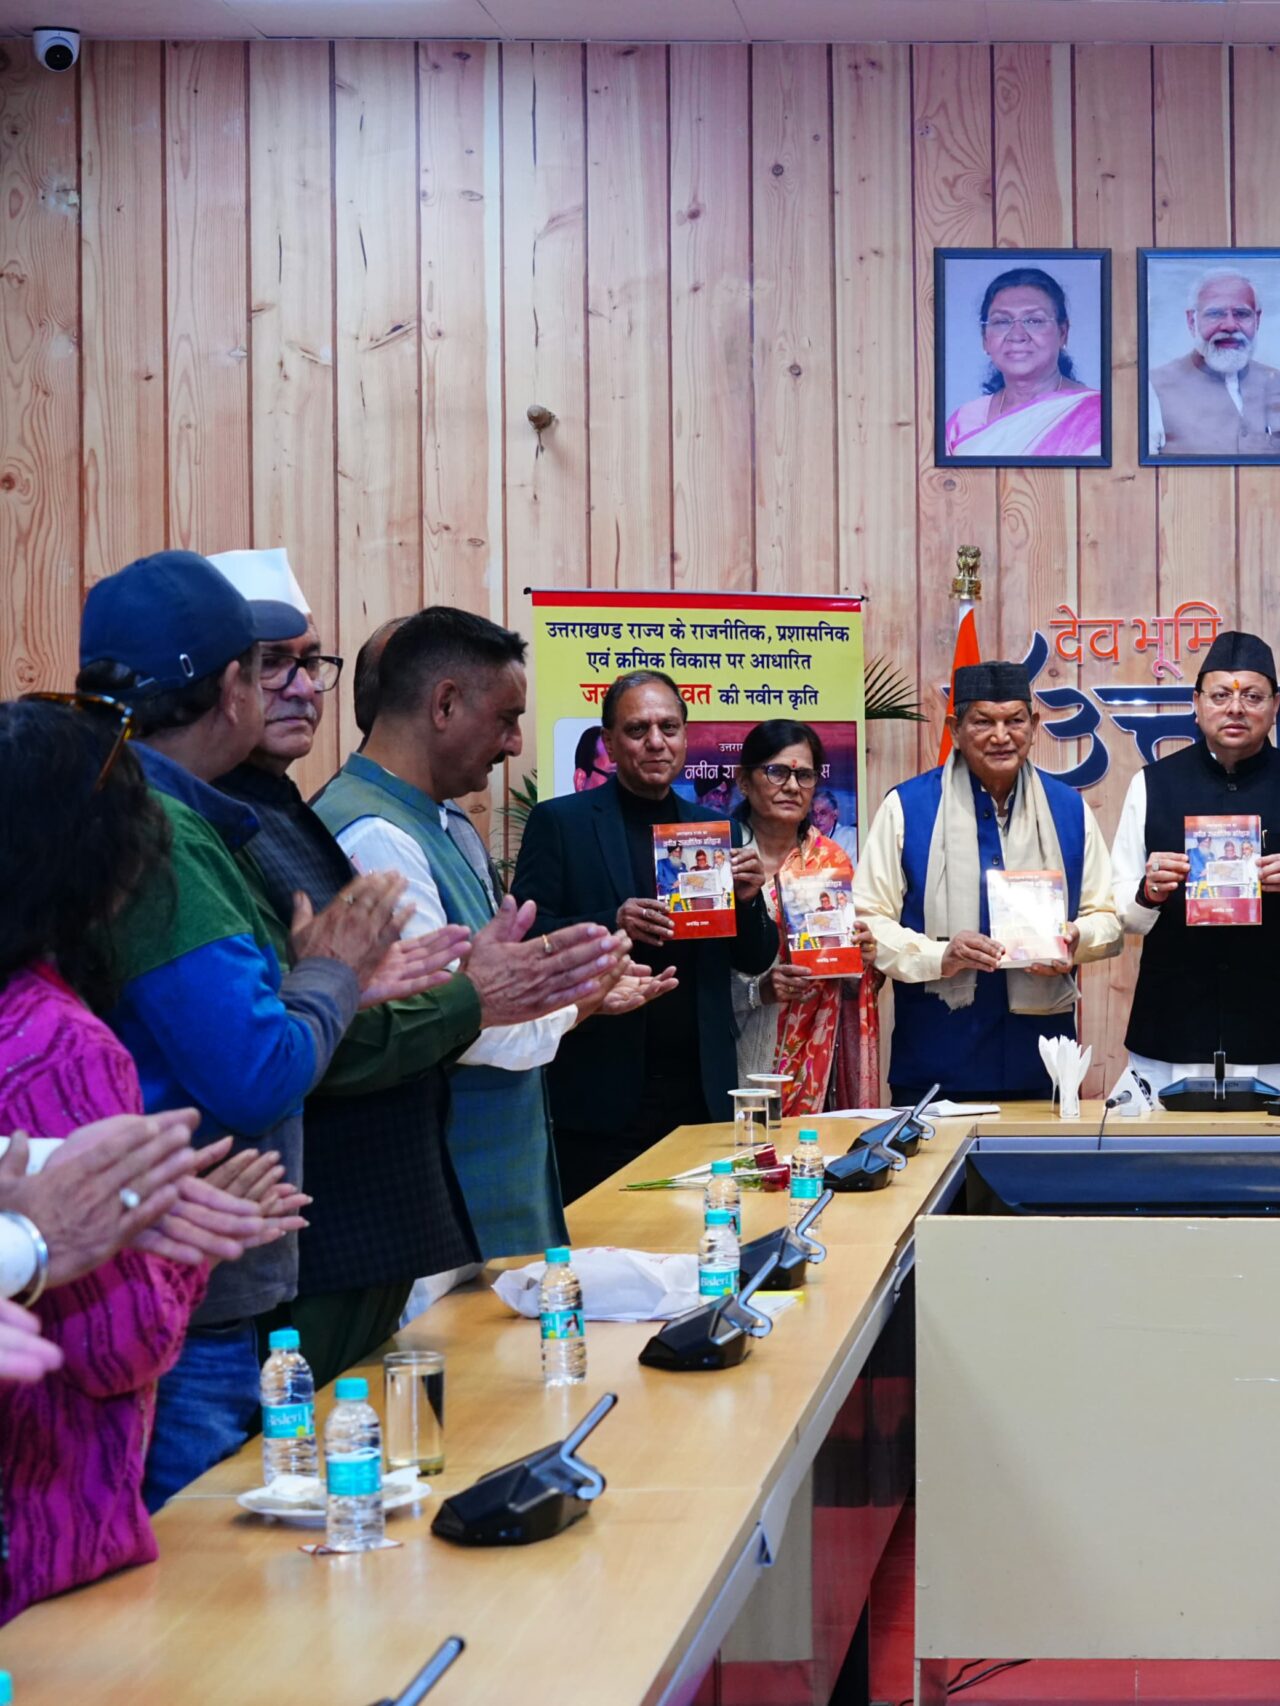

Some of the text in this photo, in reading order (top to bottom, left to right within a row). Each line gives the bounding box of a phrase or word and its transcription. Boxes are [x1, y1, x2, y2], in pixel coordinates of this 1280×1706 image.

[545, 617, 850, 644] उत्तराखण्ड राज्य के राजनीतिक, प्रशासनिक
[586, 647, 812, 673] एवं क्रमिक विकास पर आधारित
[718, 683, 740, 705] की
[744, 683, 783, 705] नवीन
[787, 684, 819, 710] कृति
[684, 760, 719, 780] नवीन
